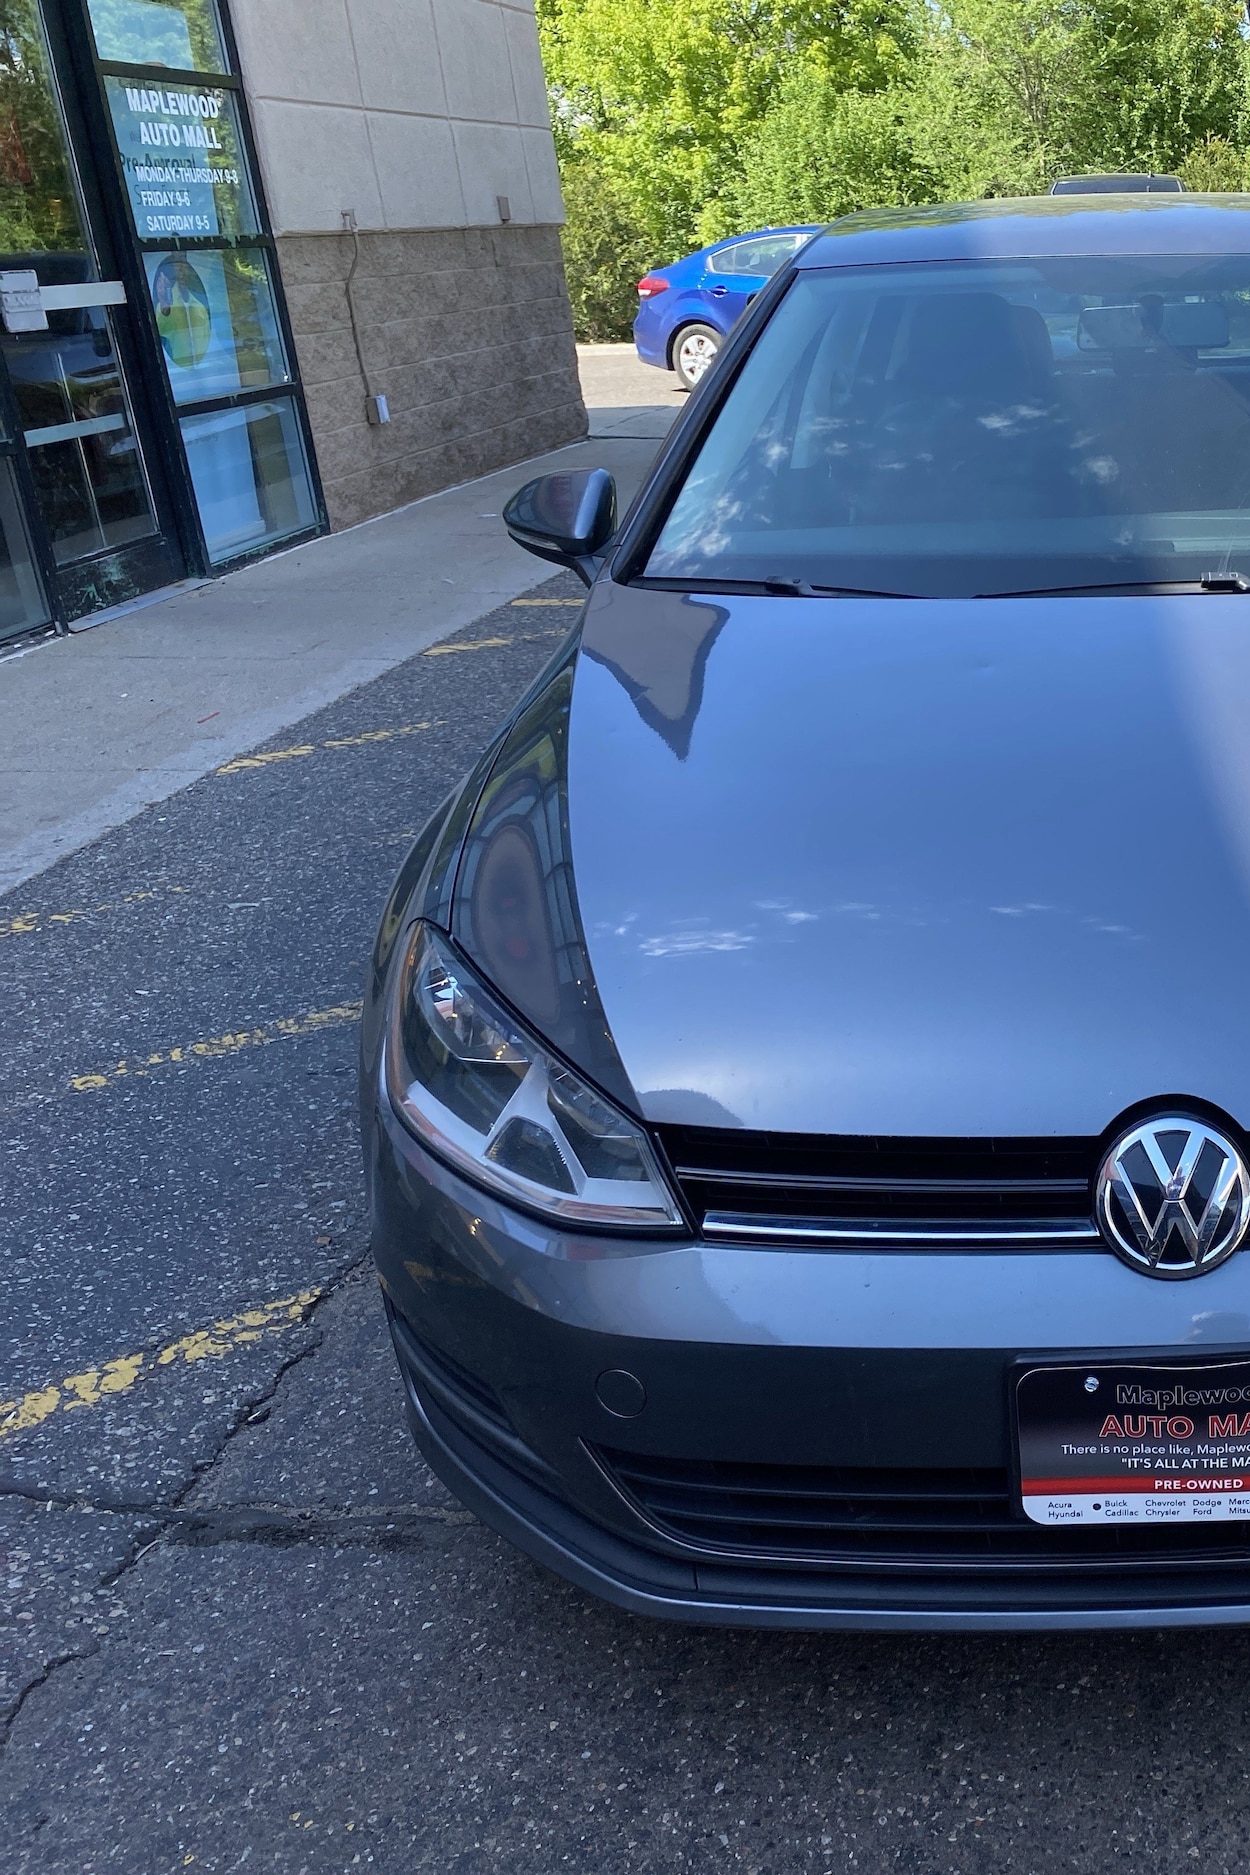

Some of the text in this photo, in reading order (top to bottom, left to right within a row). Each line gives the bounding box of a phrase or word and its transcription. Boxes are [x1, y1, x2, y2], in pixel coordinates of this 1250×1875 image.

[125, 87, 219, 119] MAPLEWOOD
[140, 121, 222, 149] AUTO MALL
[135, 166, 224, 184] MONDAY-THURSDAY
[141, 191, 175, 207] FRIDAY
[175, 191, 191, 207] 9-6
[146, 215, 210, 232] SATURDAY 9-5
[1099, 1415, 1195, 1439] AUTO
[1061, 1444, 1097, 1455] There
[1100, 1444, 1110, 1454] is
[1113, 1445, 1129, 1454] no
[1132, 1443, 1166, 1456] place
[1169, 1443, 1193, 1456] like,
[1121, 1457, 1151, 1469] "IT'S
[1154, 1458, 1180, 1469] ALL
[1181, 1458, 1200, 1469] AT
[1201, 1457, 1228, 1469] THE
[1154, 1478, 1243, 1490] PRE-OWNED
[1145, 1499, 1186, 1507] Chevrolet
[1192, 1499, 1222, 1508] Dodge
[1048, 1510, 1083, 1519] Hyundai
[1104, 1509, 1139, 1517] Cadillac
[1145, 1508, 1180, 1518] Chrysler
